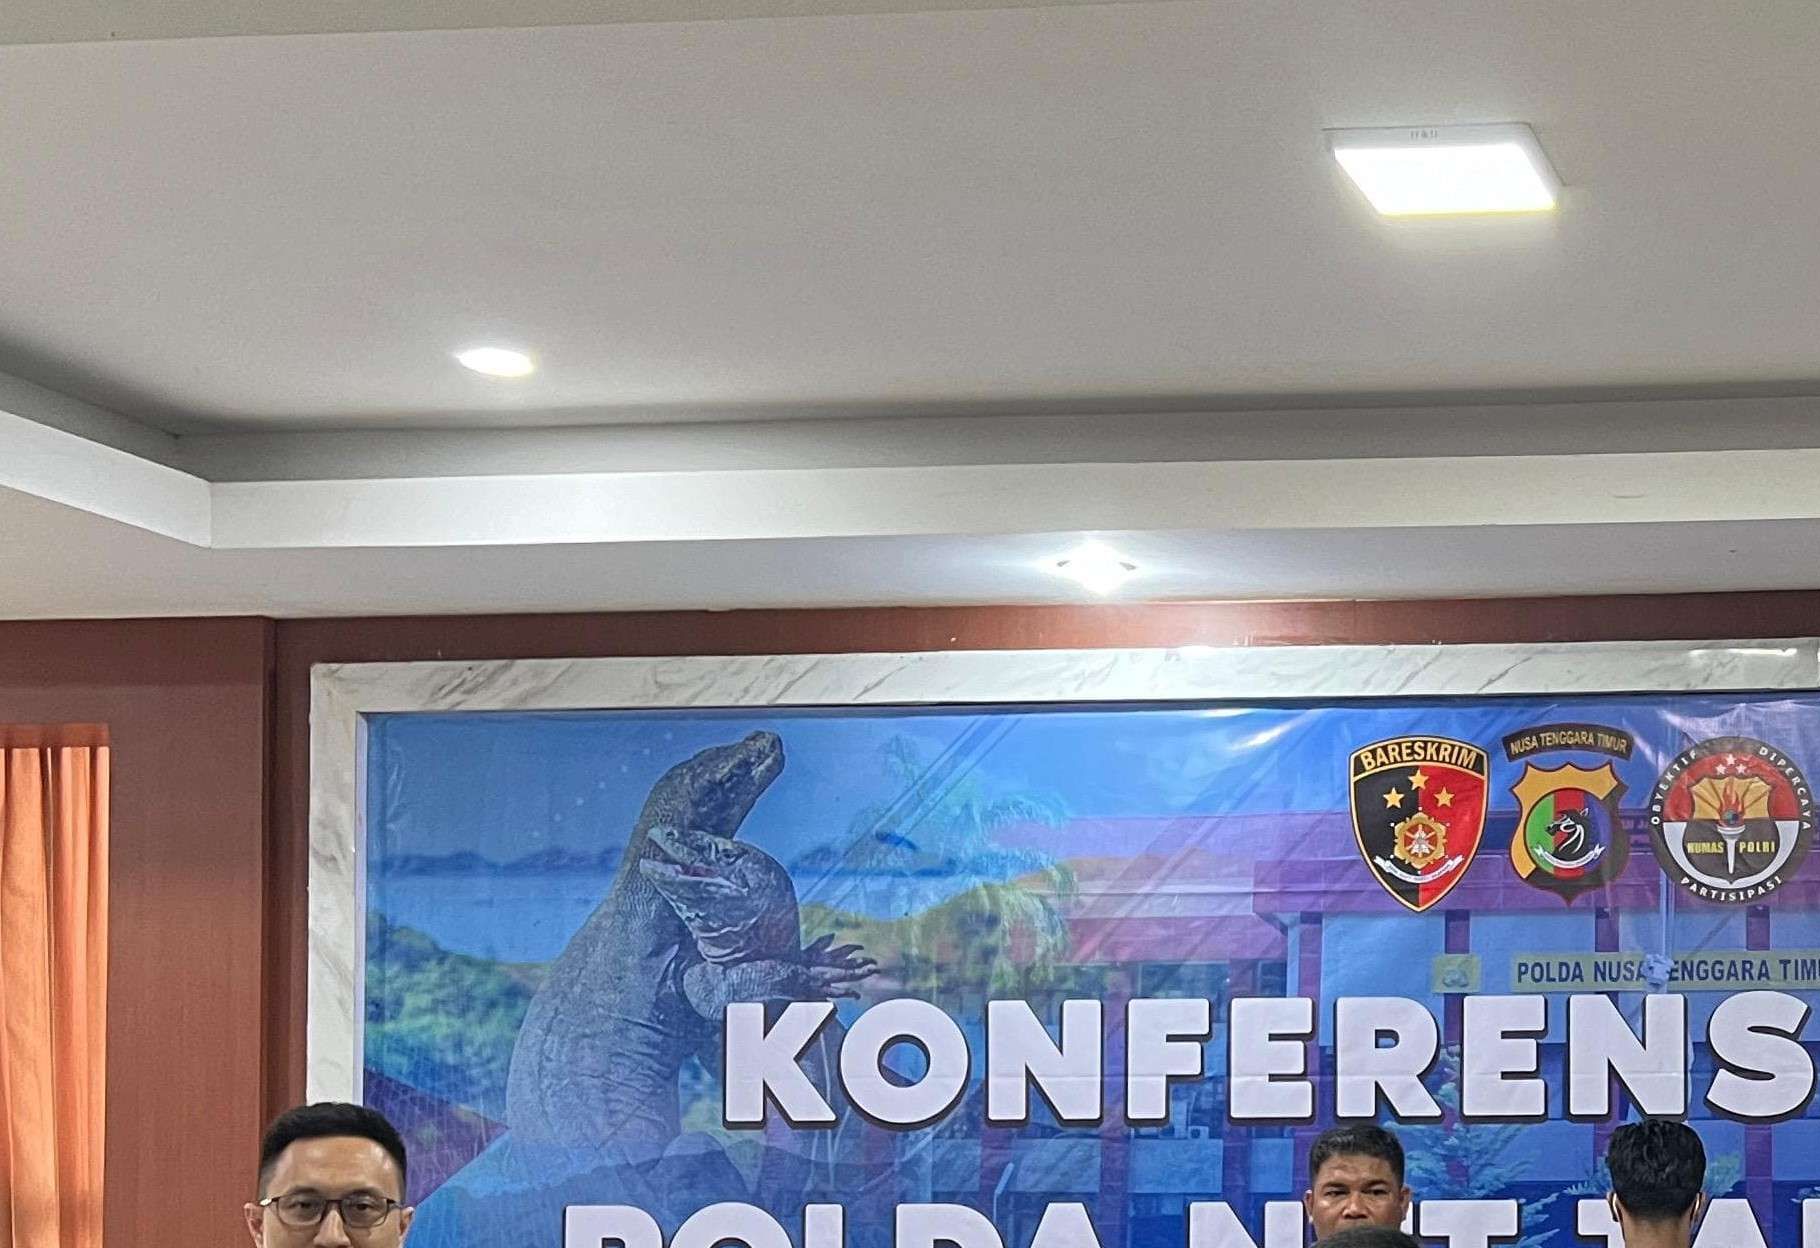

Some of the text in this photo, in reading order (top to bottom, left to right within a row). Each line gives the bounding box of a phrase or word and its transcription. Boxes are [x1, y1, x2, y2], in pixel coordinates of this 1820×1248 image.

[1360, 741, 1477, 771] BARESKRIM
[1510, 730, 1628, 755] NUSA TENGGARA TIMUR
[1650, 750, 1697, 826] OBYEKTIF
[1759, 746, 1812, 830] DIPERCAYA
[1687, 841, 1776, 855] HUMAS POLRI
[1680, 875, 1783, 902] PARTISIPASI
[1516, 961, 1584, 983] POLDA
[1667, 959, 1771, 982] ENGGARA
